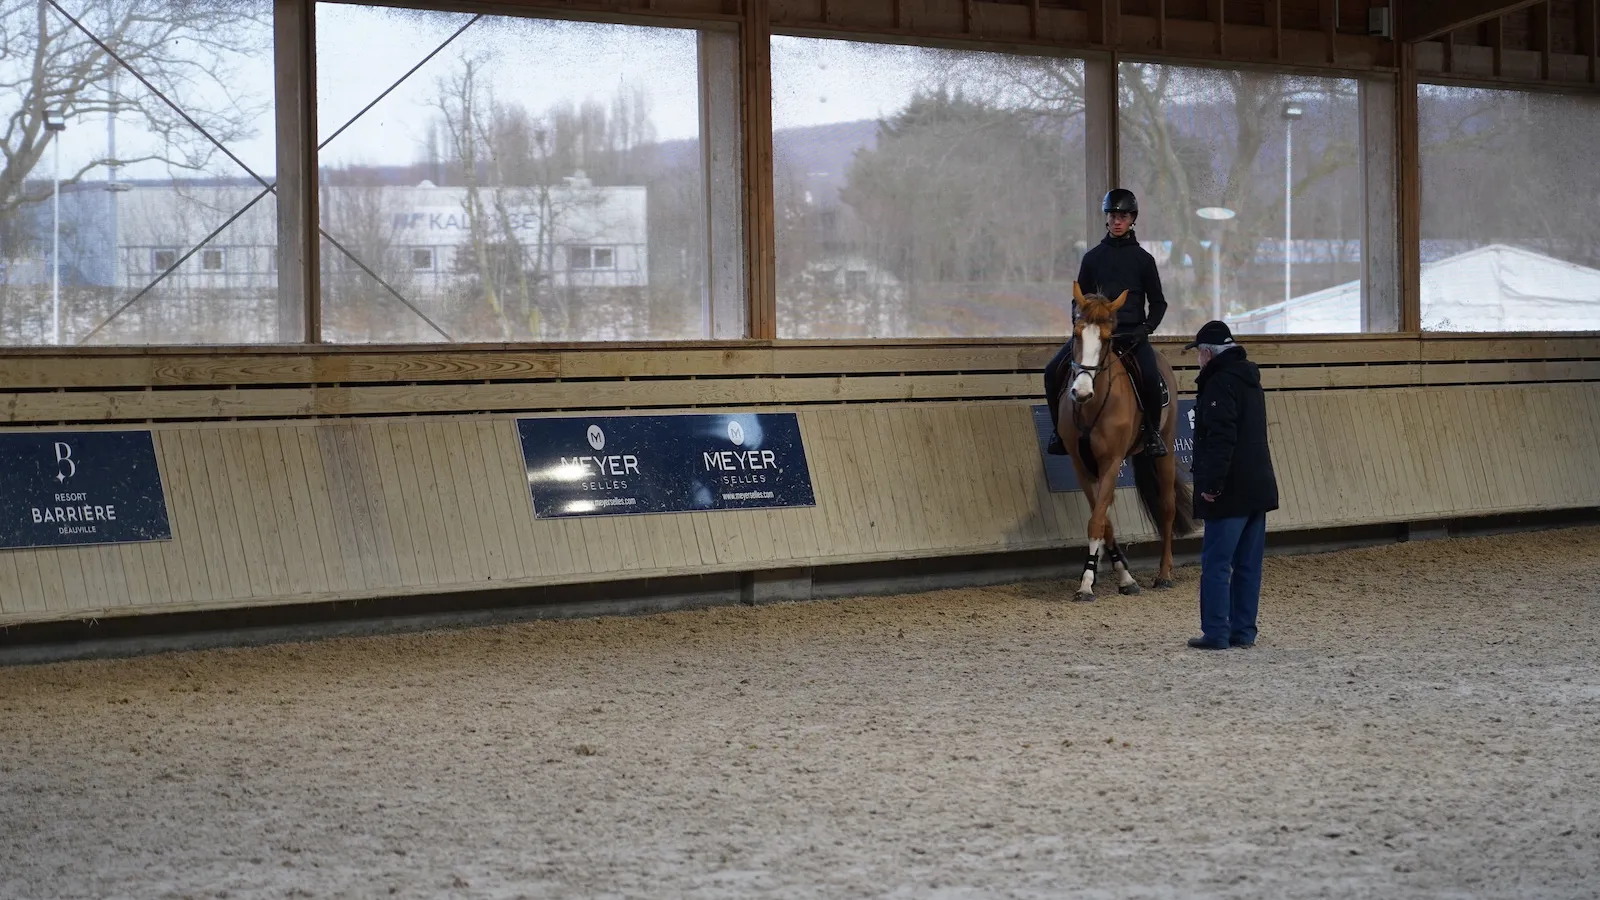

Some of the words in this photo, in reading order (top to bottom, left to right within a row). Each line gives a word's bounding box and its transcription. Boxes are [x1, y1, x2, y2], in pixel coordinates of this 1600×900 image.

[703, 450, 777, 471] MEYER
[723, 474, 766, 484] SELLES
[581, 480, 628, 491] SELLES
[55, 492, 87, 502] RESORT
[722, 490, 774, 501] www.meyerselles.com
[31, 504, 117, 523] BARRIÈRE
[58, 526, 96, 535] DEAUVILLE
